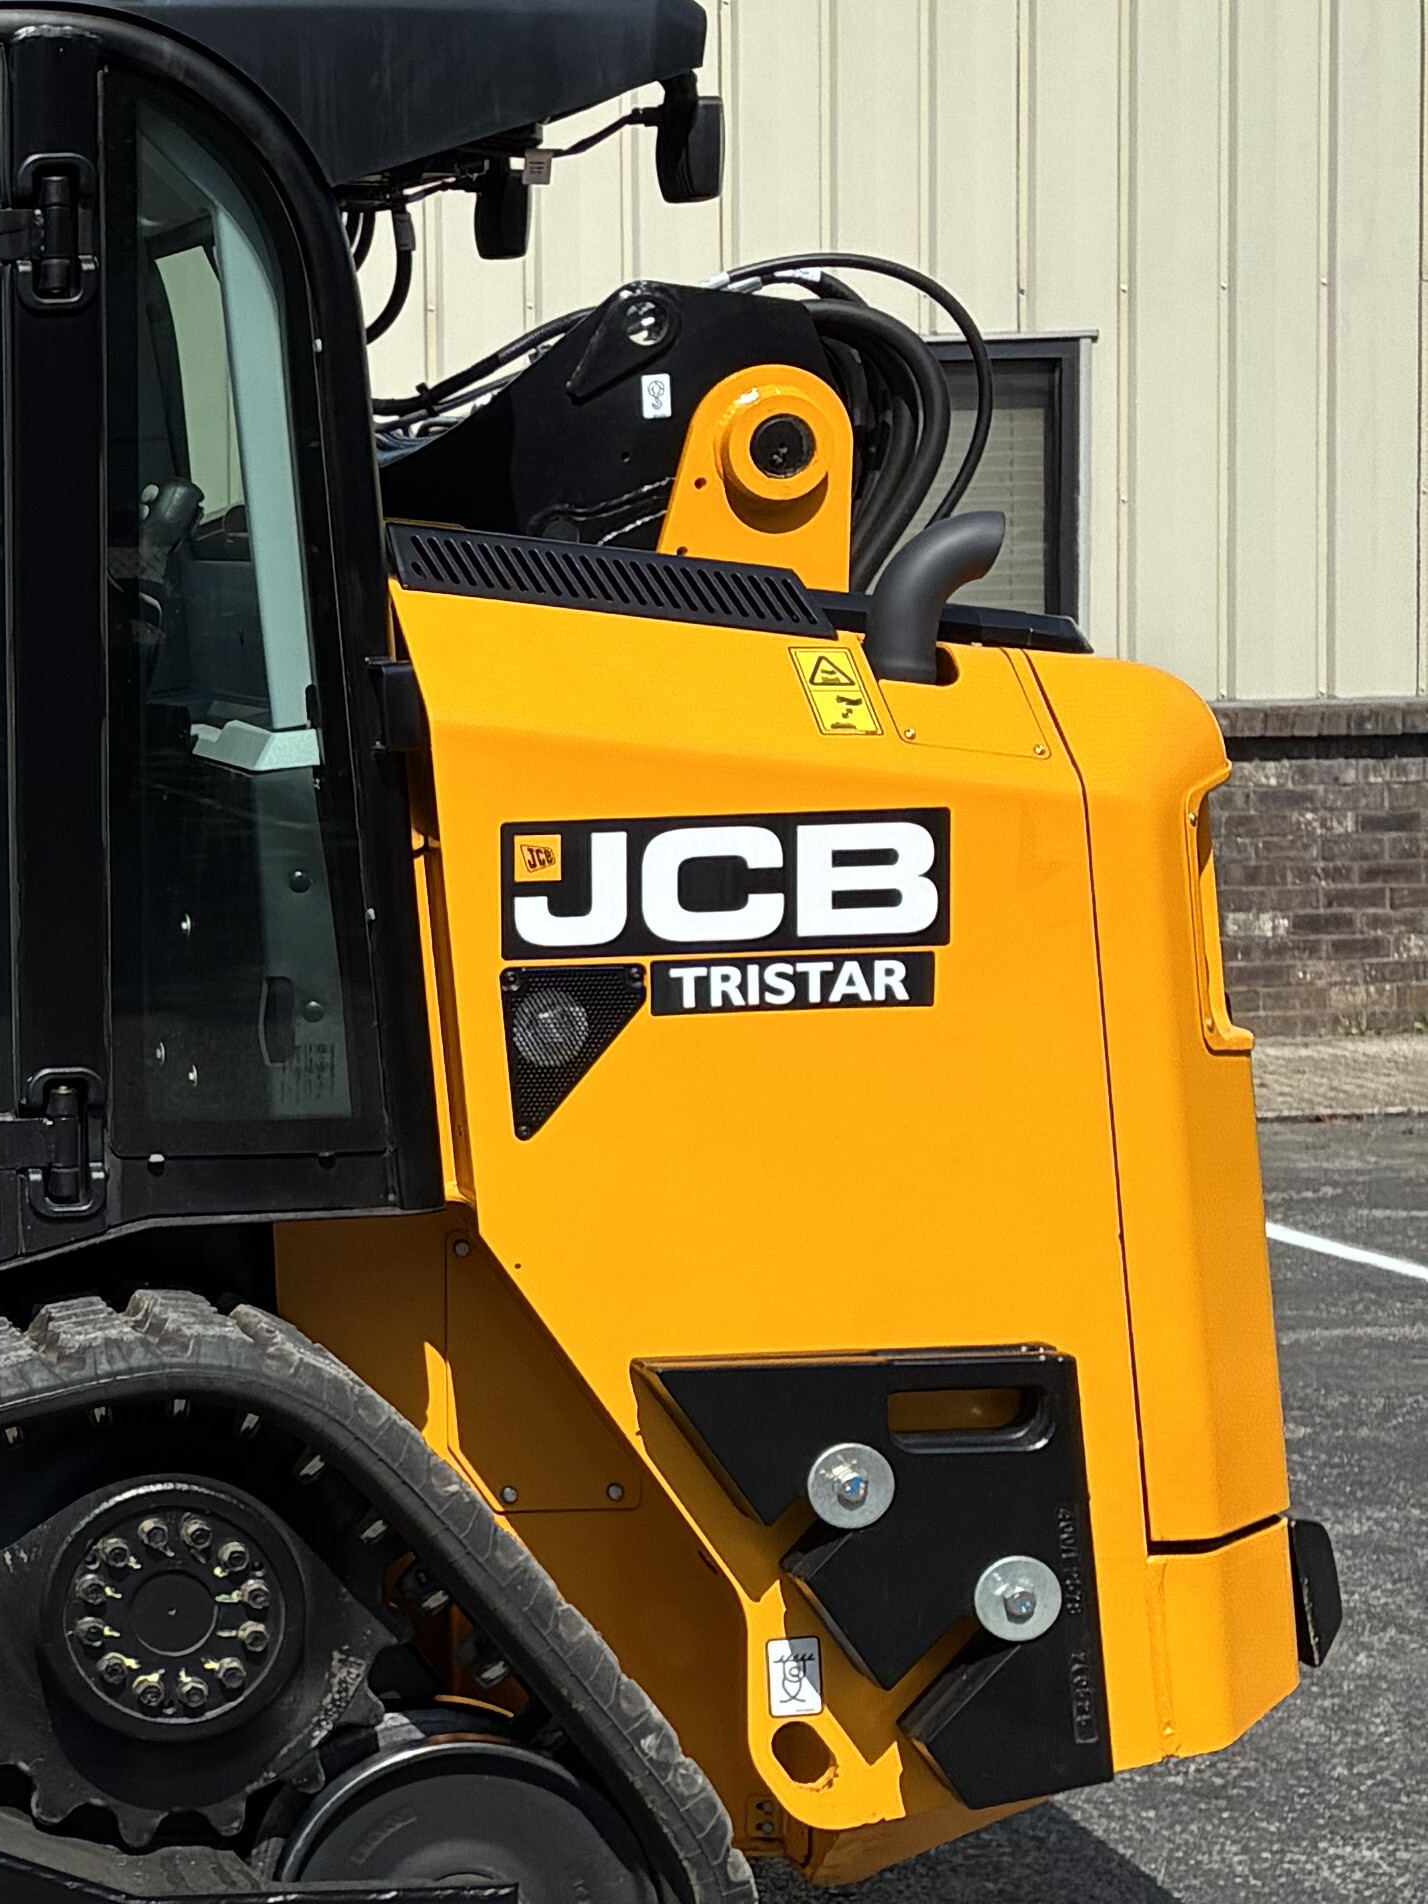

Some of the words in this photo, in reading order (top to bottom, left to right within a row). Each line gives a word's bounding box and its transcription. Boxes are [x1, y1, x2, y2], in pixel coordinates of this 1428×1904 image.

[527, 847, 554, 869] JCB
[513, 820, 938, 947] JCB
[669, 960, 910, 1010] TRISTAR
